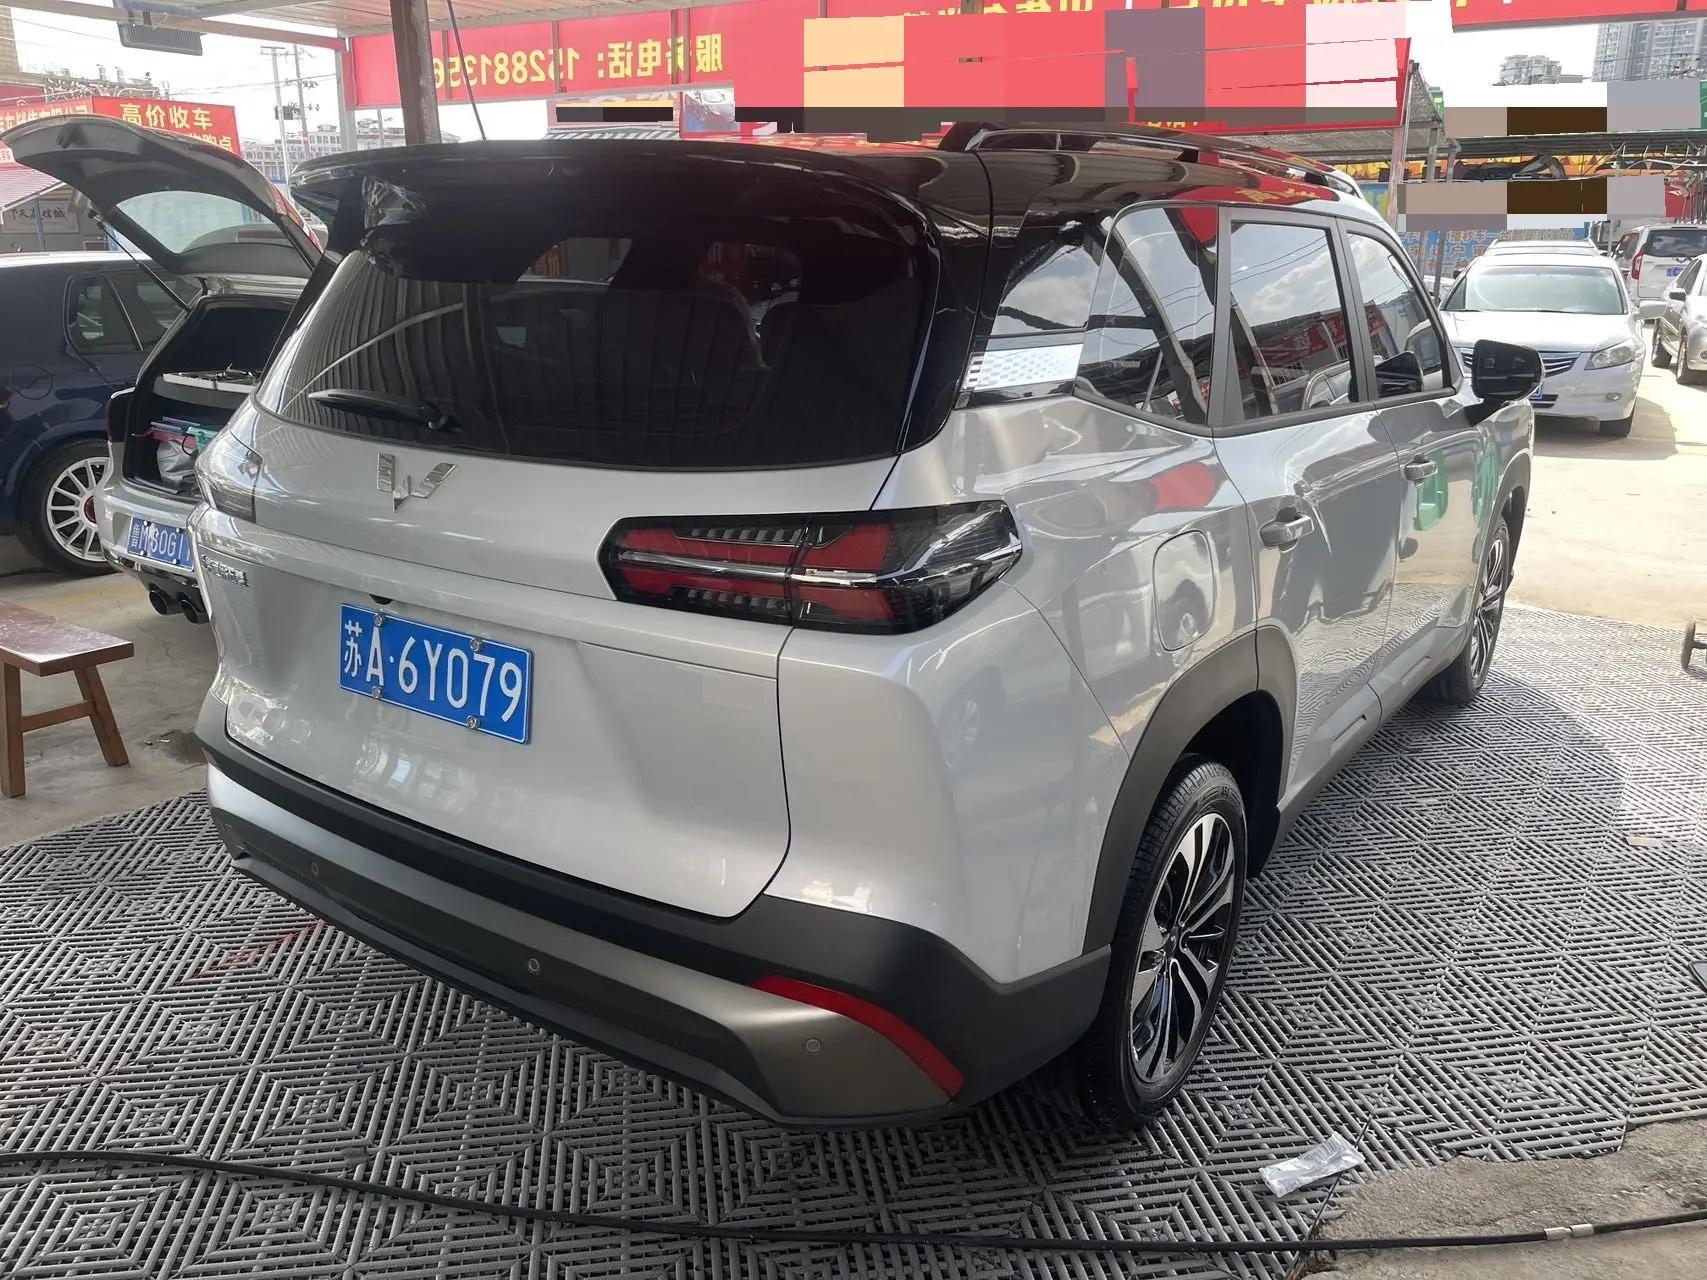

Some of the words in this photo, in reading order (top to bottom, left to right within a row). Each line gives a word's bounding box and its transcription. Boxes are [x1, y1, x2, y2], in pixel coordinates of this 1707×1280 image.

[119, 102, 213, 130] 高价收车
[344, 618, 523, 723] 苏A·6Y079
